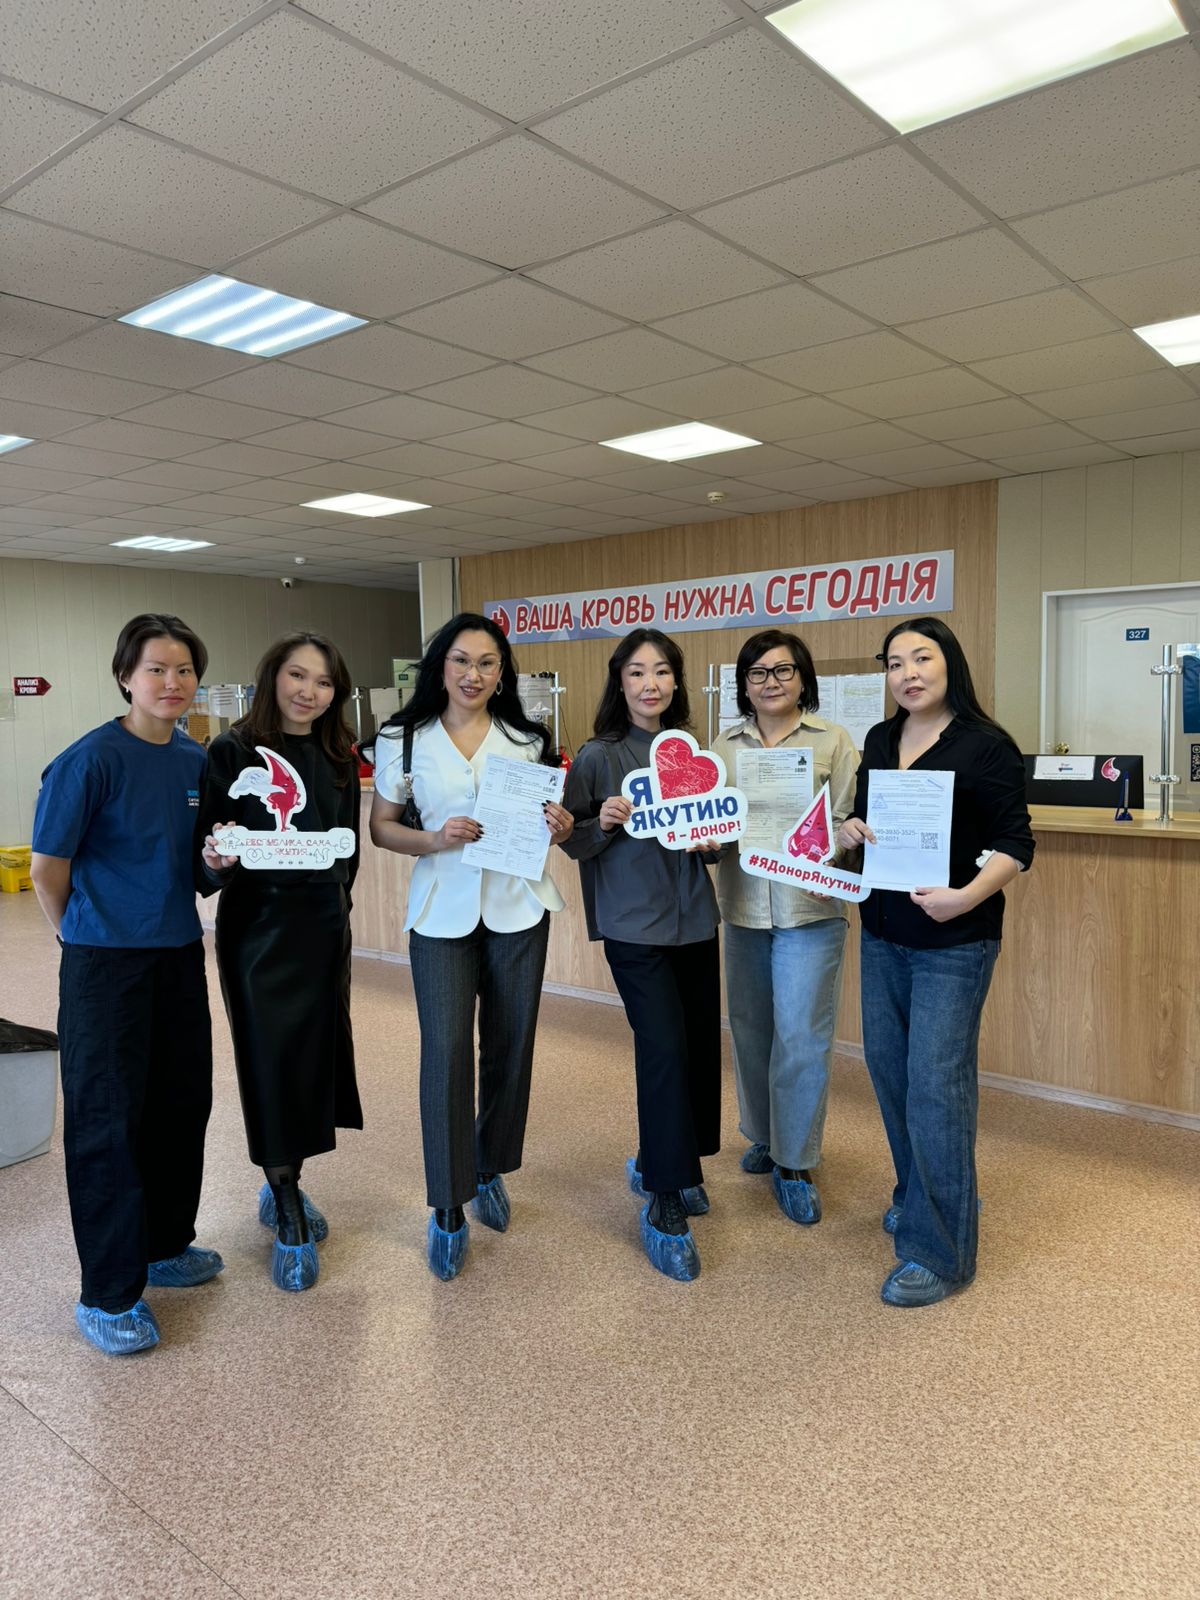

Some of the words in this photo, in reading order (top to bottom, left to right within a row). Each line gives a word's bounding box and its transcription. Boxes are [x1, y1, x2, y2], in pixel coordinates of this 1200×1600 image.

[515, 601, 574, 633] ВАША
[580, 594, 656, 628] КРОВЬ
[664, 583, 755, 621] НУЖНА
[765, 558, 939, 614] СЕГОДНЯ
[1128, 630, 1146, 639] 327
[629, 776, 654, 807] Я
[631, 796, 739, 832] ЯКУТИЮ
[667, 831, 676, 843] Я
[690, 820, 742, 841] ДОНОР!
[749, 854, 861, 894] #ЯДонорЯкутии
